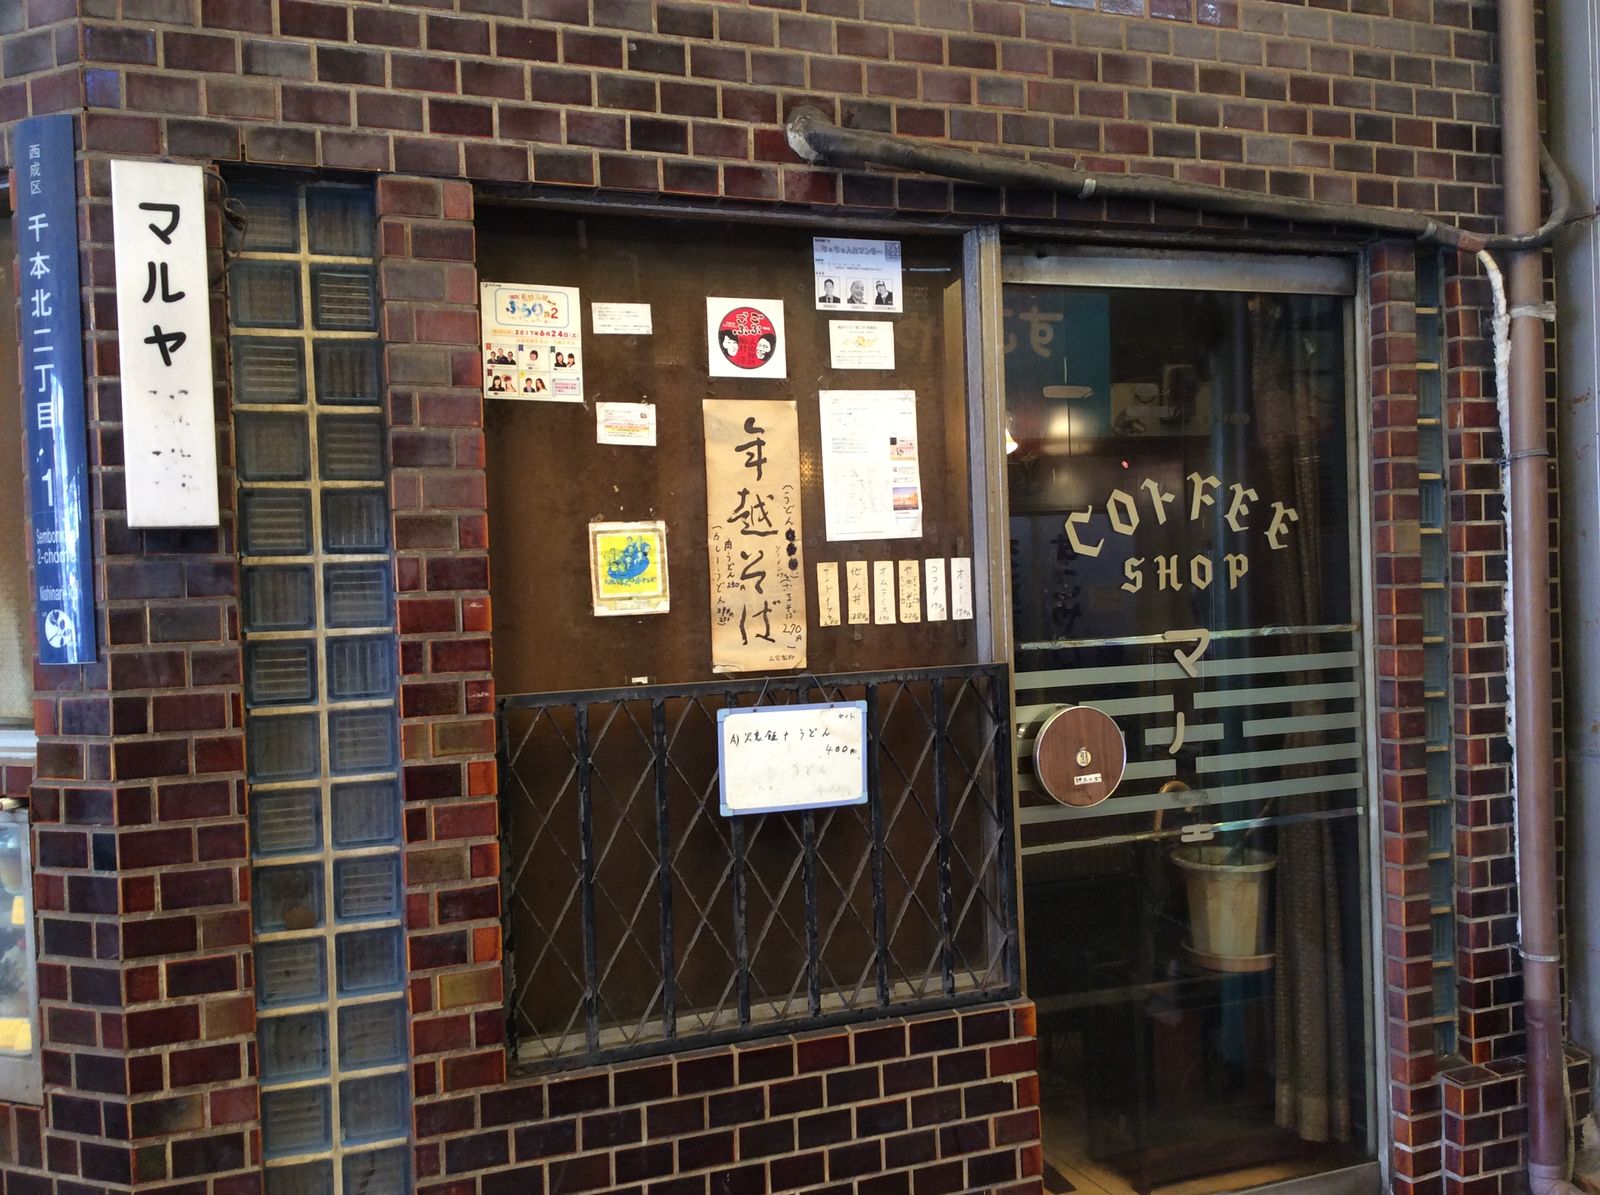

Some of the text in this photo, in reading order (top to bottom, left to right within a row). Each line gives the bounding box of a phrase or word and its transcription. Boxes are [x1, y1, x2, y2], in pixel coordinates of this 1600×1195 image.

[28, 143, 43, 195] 西成区
[138, 202, 188, 367] マルヤ
[727, 416, 781, 647] 年越そば
[1064, 472, 1299, 557] COFFEE
[1120, 553, 1249, 593] SHOP
